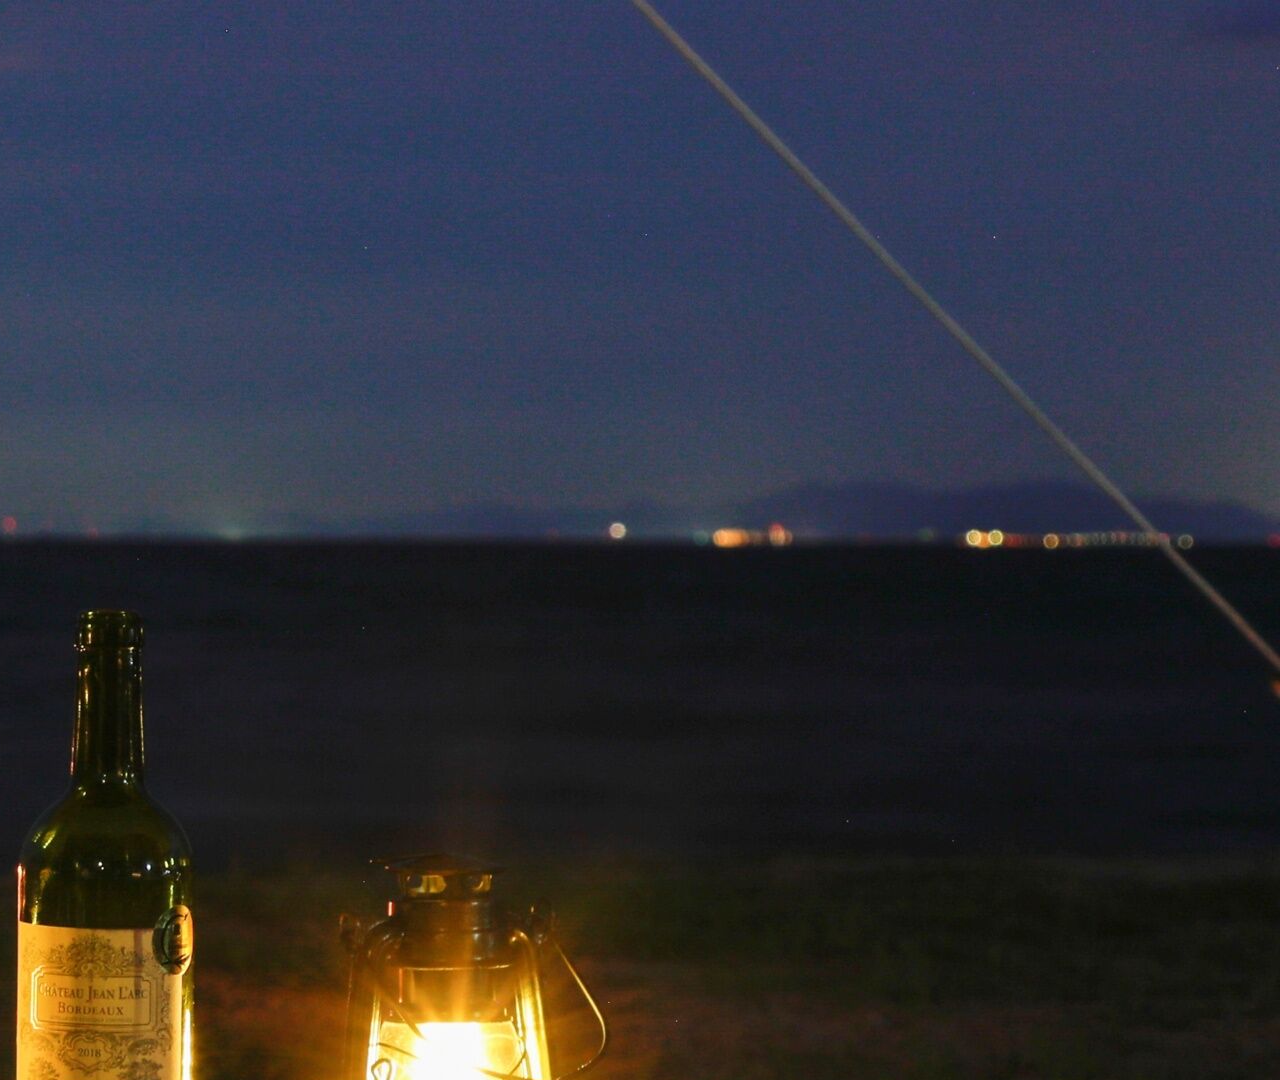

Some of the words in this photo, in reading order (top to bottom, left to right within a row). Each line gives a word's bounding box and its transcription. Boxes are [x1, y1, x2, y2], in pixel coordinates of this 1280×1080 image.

[86, 986, 115, 1002] JEAN
[58, 1001, 124, 1016] BORDEAUX
[78, 1048, 101, 1057] 2018
